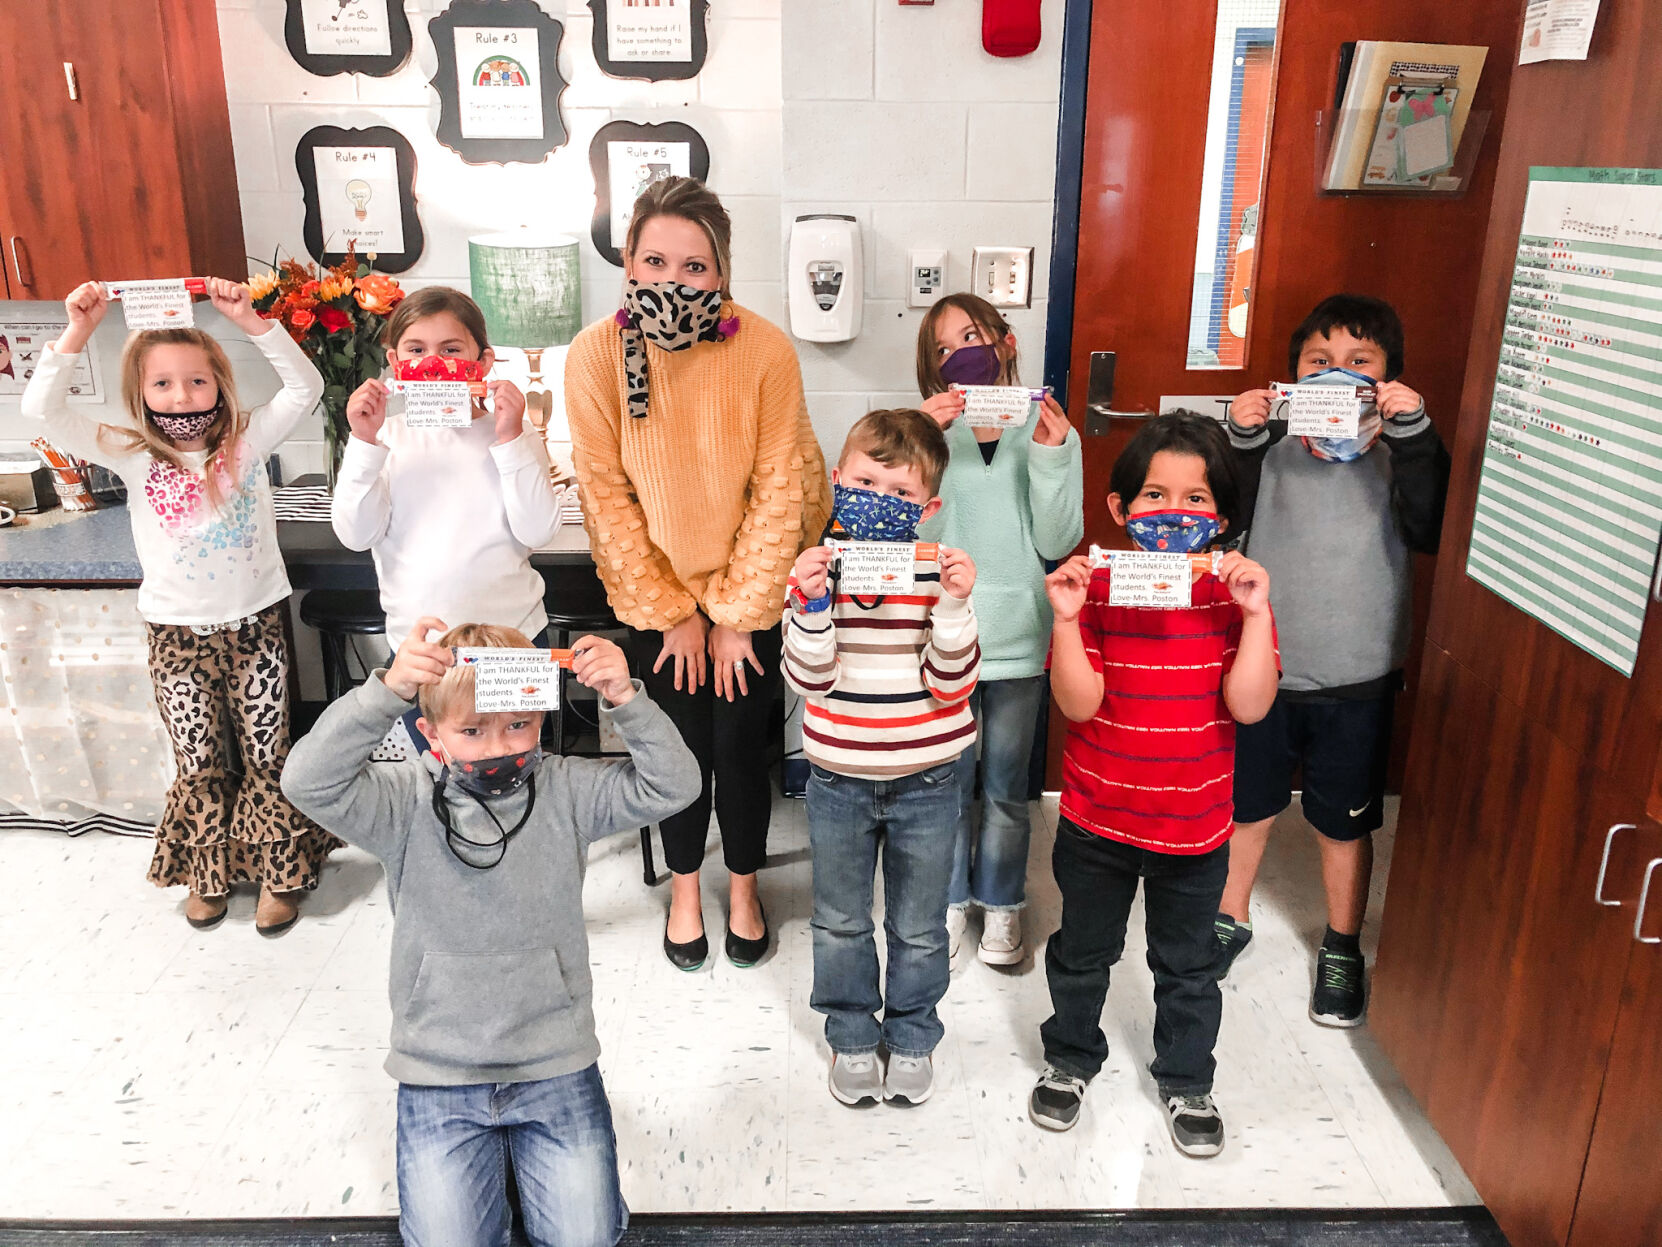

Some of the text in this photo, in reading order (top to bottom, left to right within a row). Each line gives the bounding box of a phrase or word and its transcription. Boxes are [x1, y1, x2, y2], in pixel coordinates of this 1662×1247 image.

[342, 24, 378, 33] directions
[650, 24, 668, 33] hand
[335, 36, 360, 47] quickly
[475, 32, 518, 44] Rule #3
[636, 37, 672, 47] something
[626, 48, 638, 56] ask
[335, 151, 376, 163] Rule #4
[626, 146, 667, 158] Rule #5
[494, 677, 524, 686] World's
